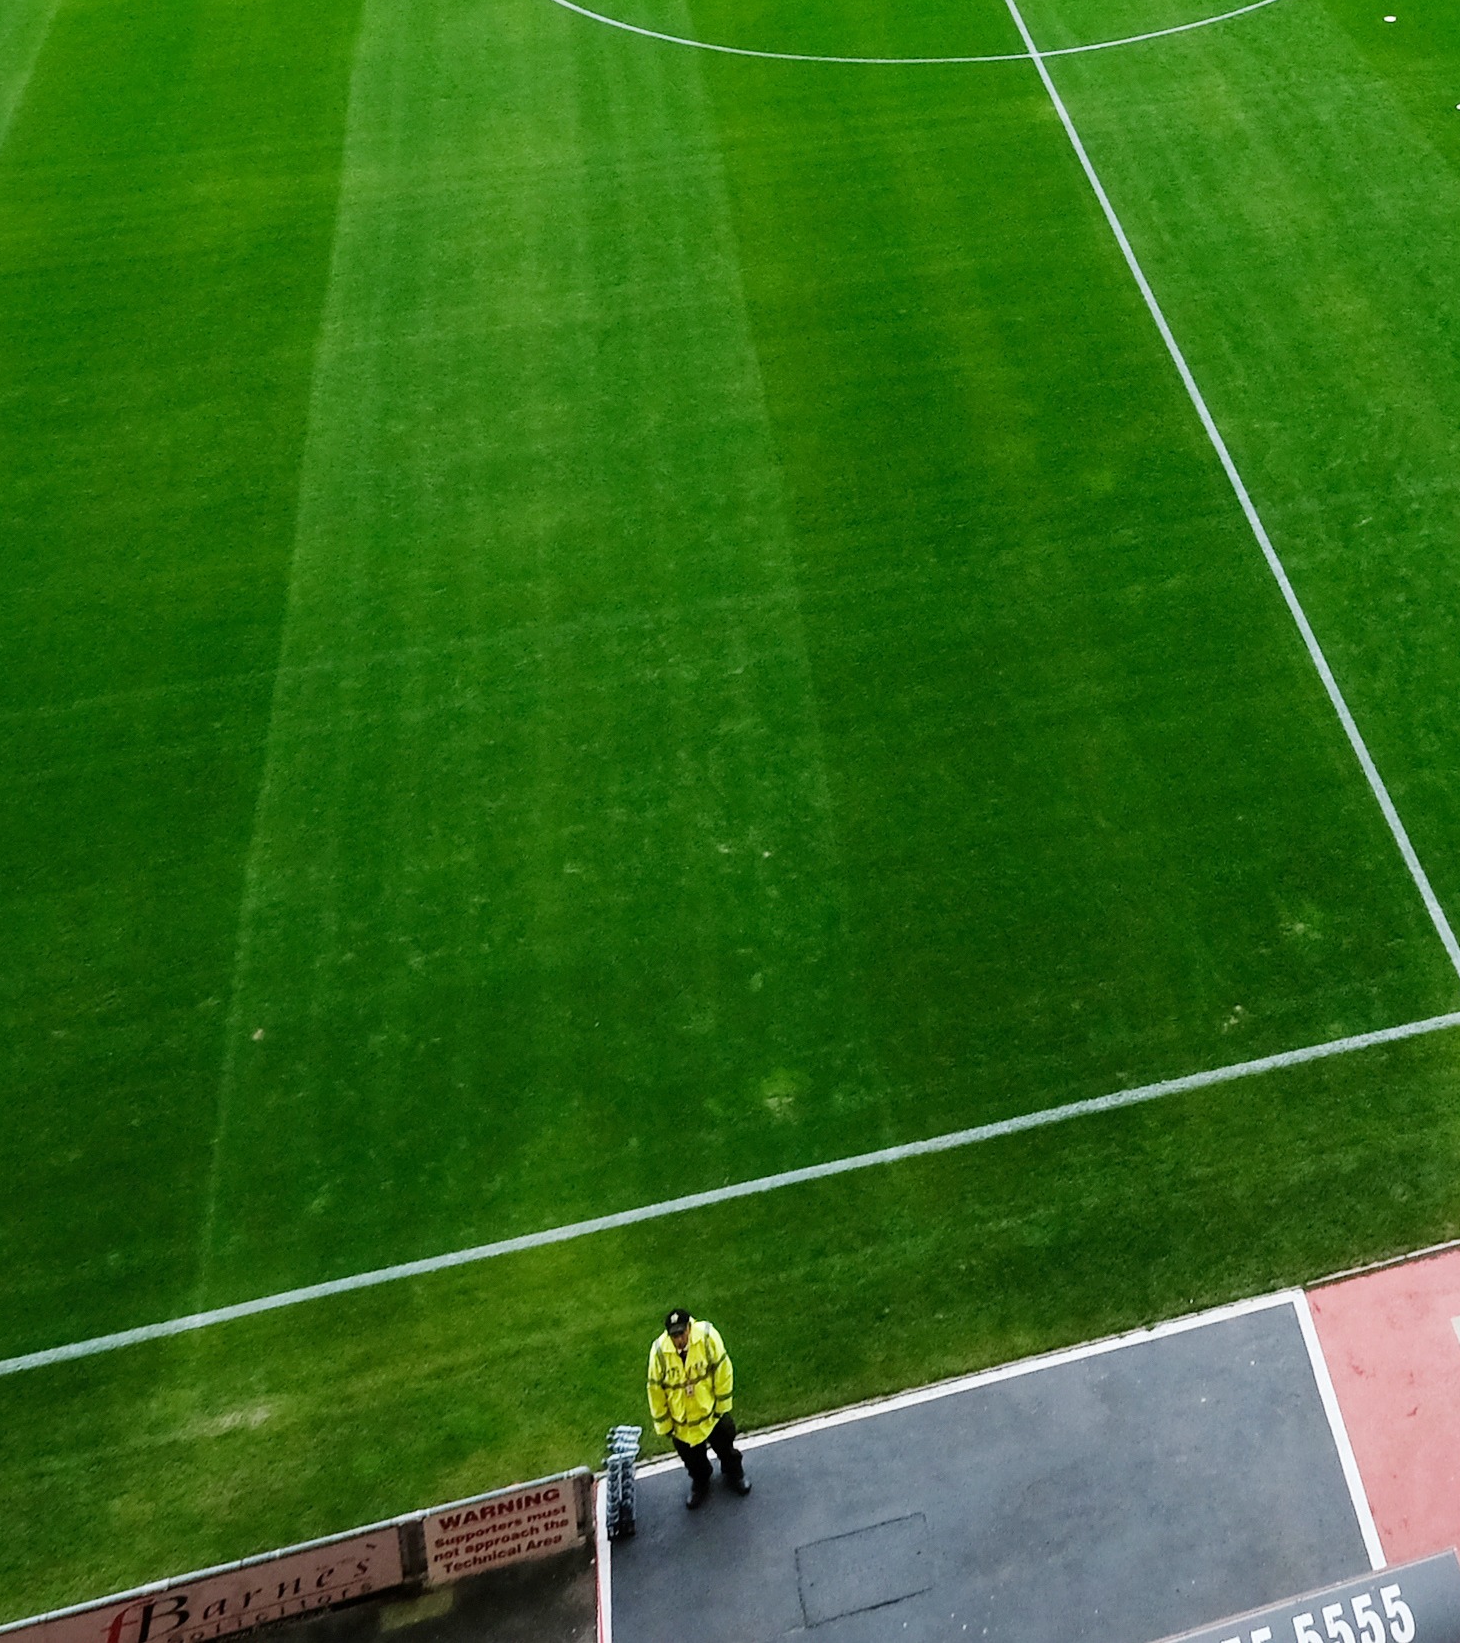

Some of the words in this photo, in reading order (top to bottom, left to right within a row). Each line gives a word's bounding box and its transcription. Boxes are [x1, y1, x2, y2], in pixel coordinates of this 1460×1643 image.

[435, 1518, 523, 1548] Supporters
[526, 1505, 567, 1523] must
[438, 1488, 561, 1530] WARNING
[434, 1548, 460, 1563] not
[464, 1526, 541, 1555] approach
[544, 1517, 569, 1532] the
[443, 1546, 522, 1575] Technical
[526, 1533, 562, 1552] Area
